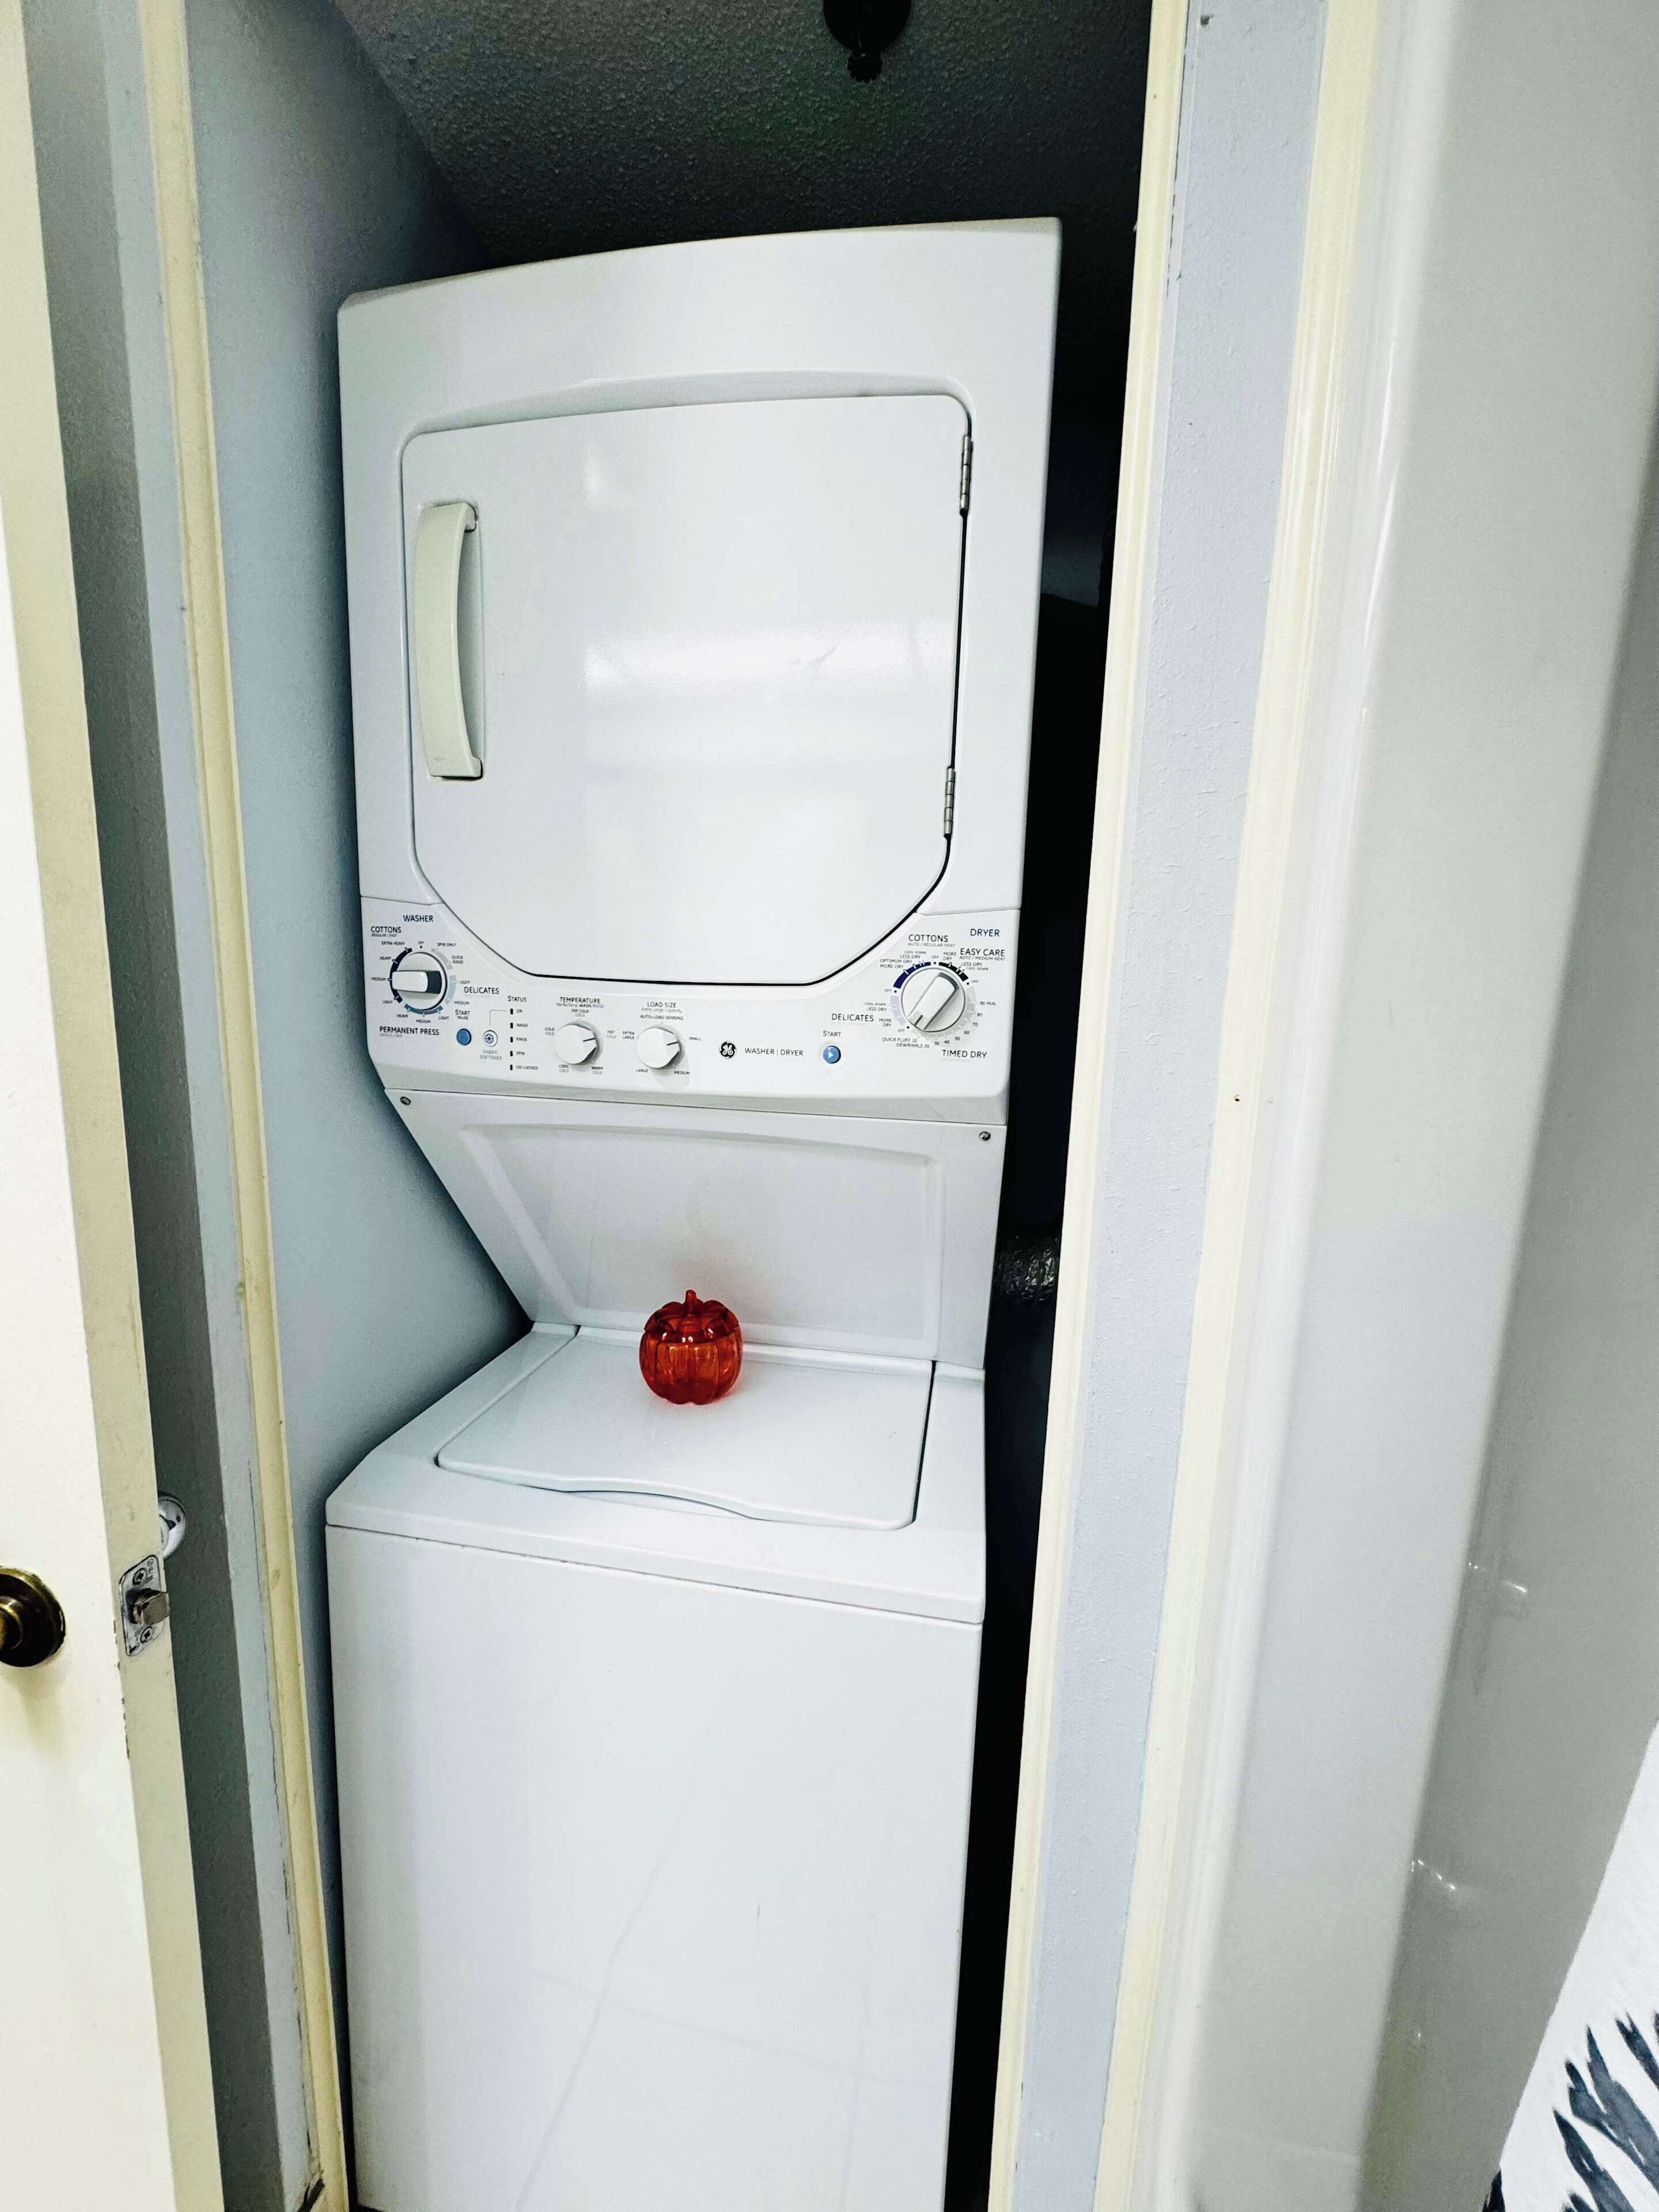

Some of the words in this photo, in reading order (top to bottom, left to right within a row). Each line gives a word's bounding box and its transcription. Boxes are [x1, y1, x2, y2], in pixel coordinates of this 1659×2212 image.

[970, 928, 1000, 937] DRYER
[908, 934, 948, 942] COTTONS
[960, 948, 981, 956] EASY
[983, 949, 1005, 957] CARE
[464, 986, 499, 994] DELICATES
[831, 1013, 874, 1022] DELICATES
[380, 1026, 418, 1034] PERMANENT
[420, 1028, 440, 1036] PRESS
[942, 1050, 968, 1058] TIMED
